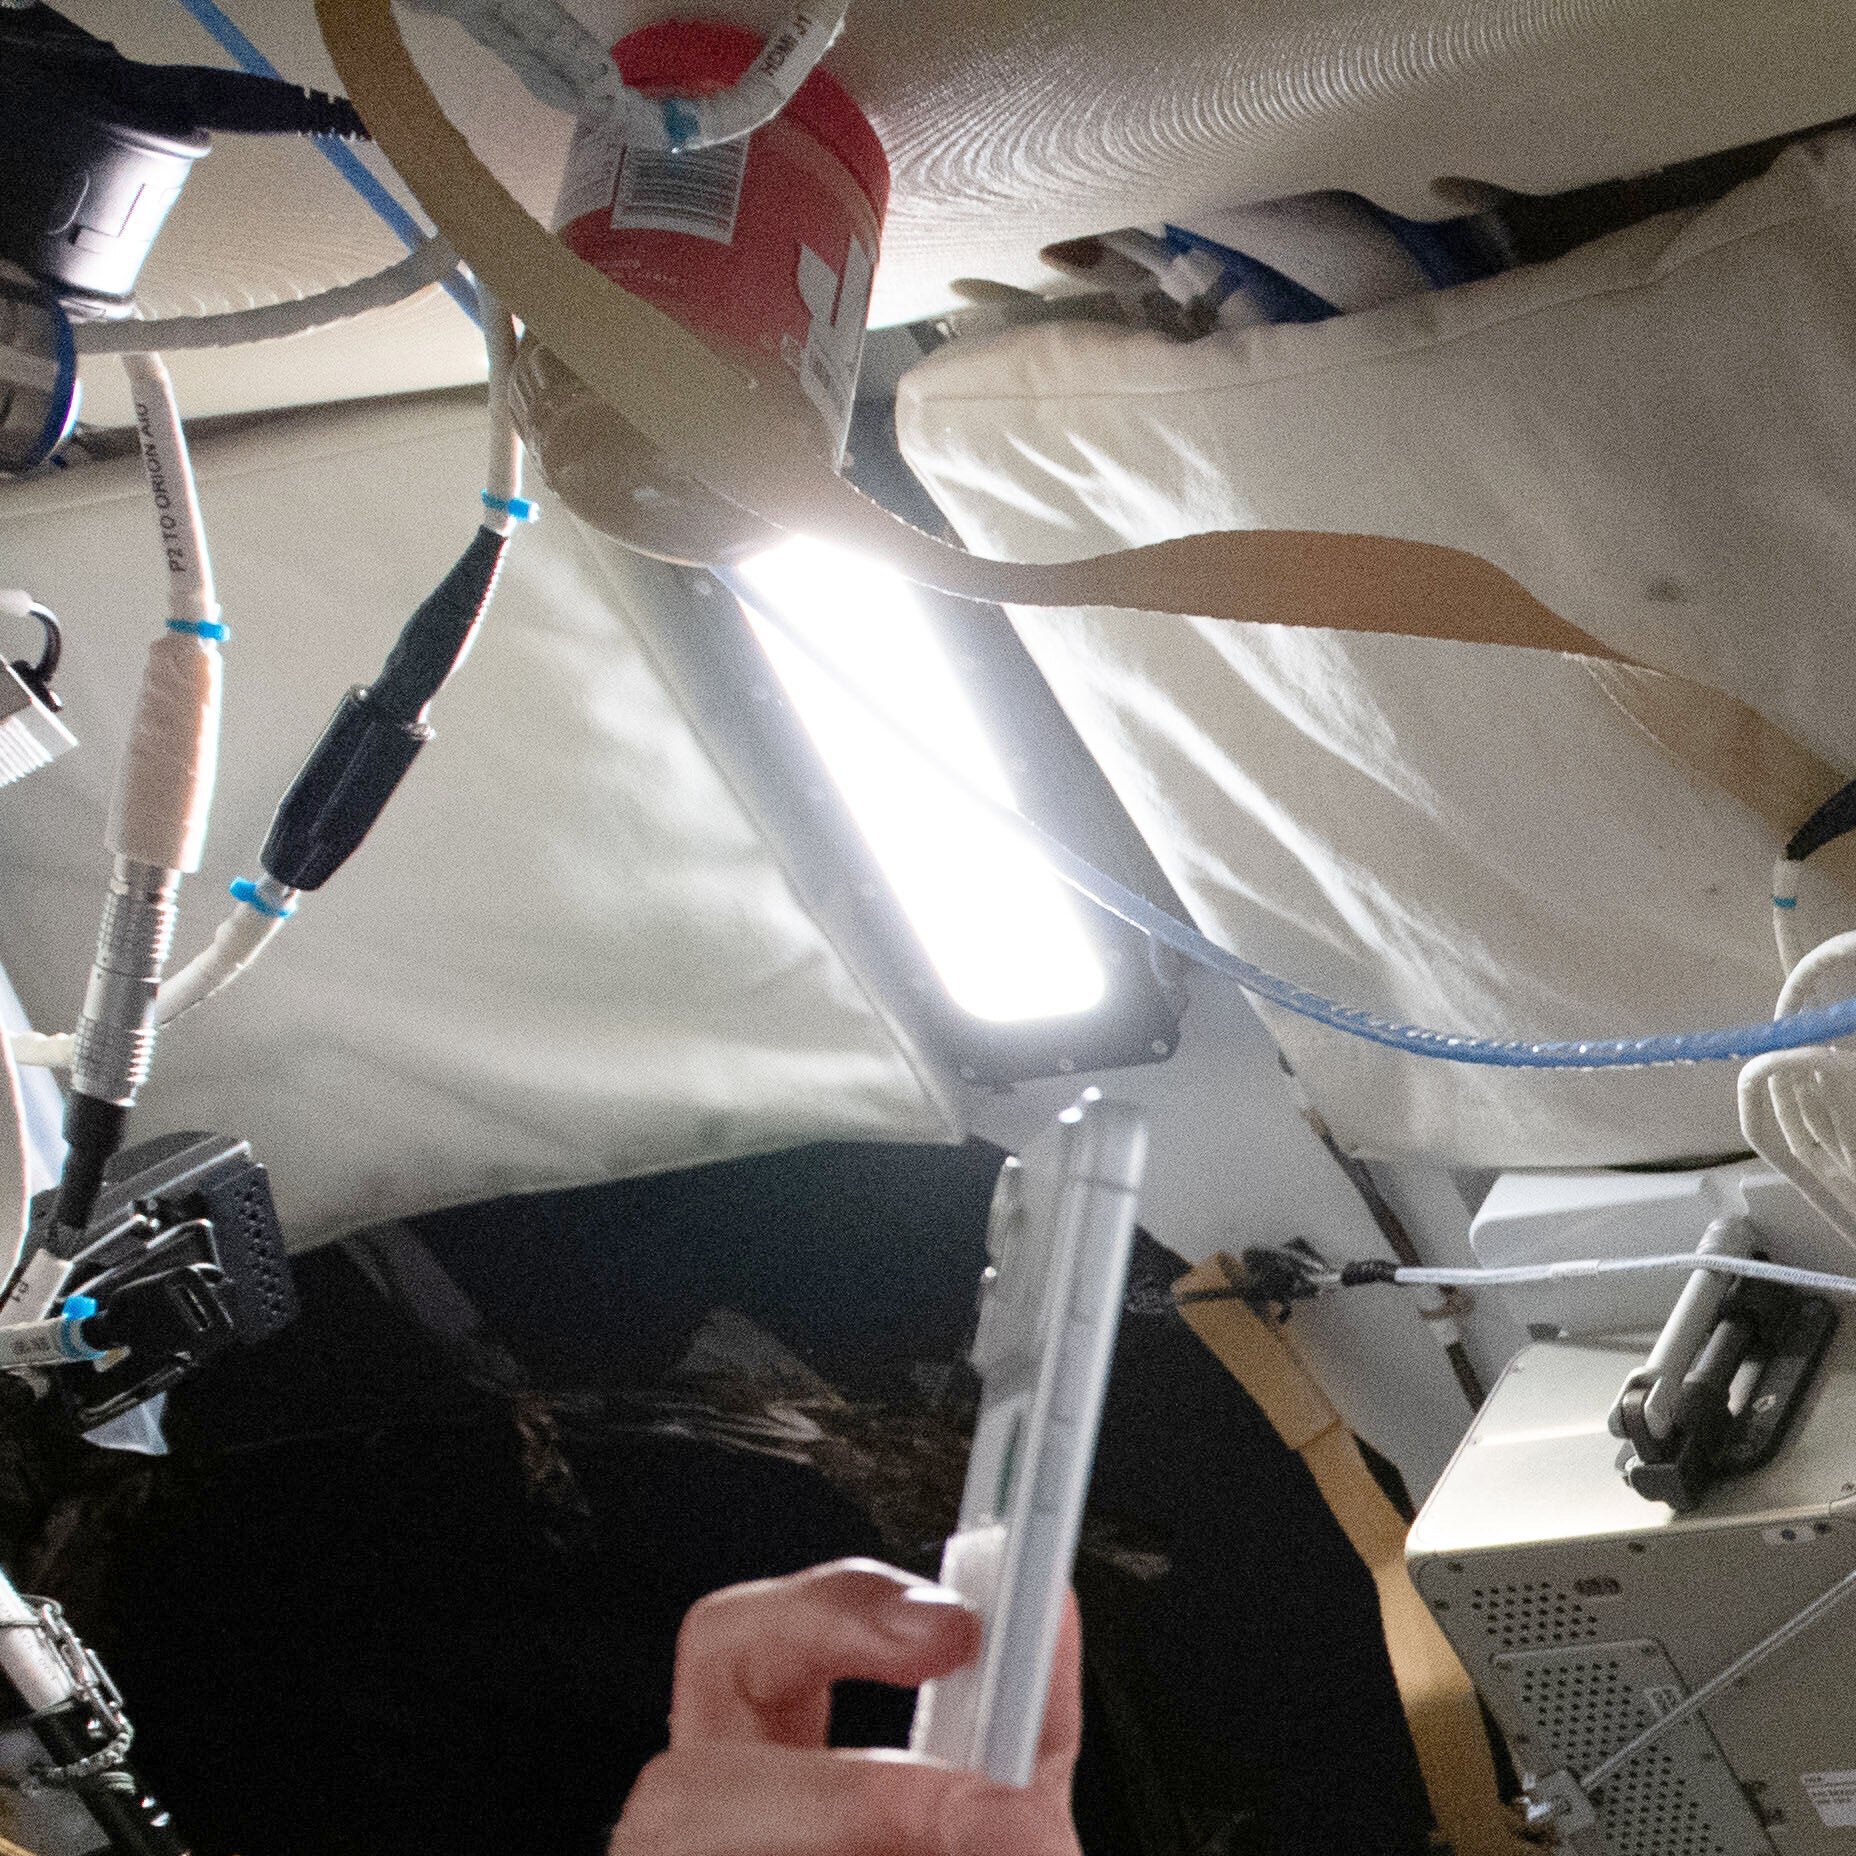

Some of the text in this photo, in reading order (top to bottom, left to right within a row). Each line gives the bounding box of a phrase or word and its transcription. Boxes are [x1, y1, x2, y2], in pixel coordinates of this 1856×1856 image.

[145, 443, 171, 509] ORION
[160, 514, 178, 541] TO
[166, 548, 187, 573] P2
